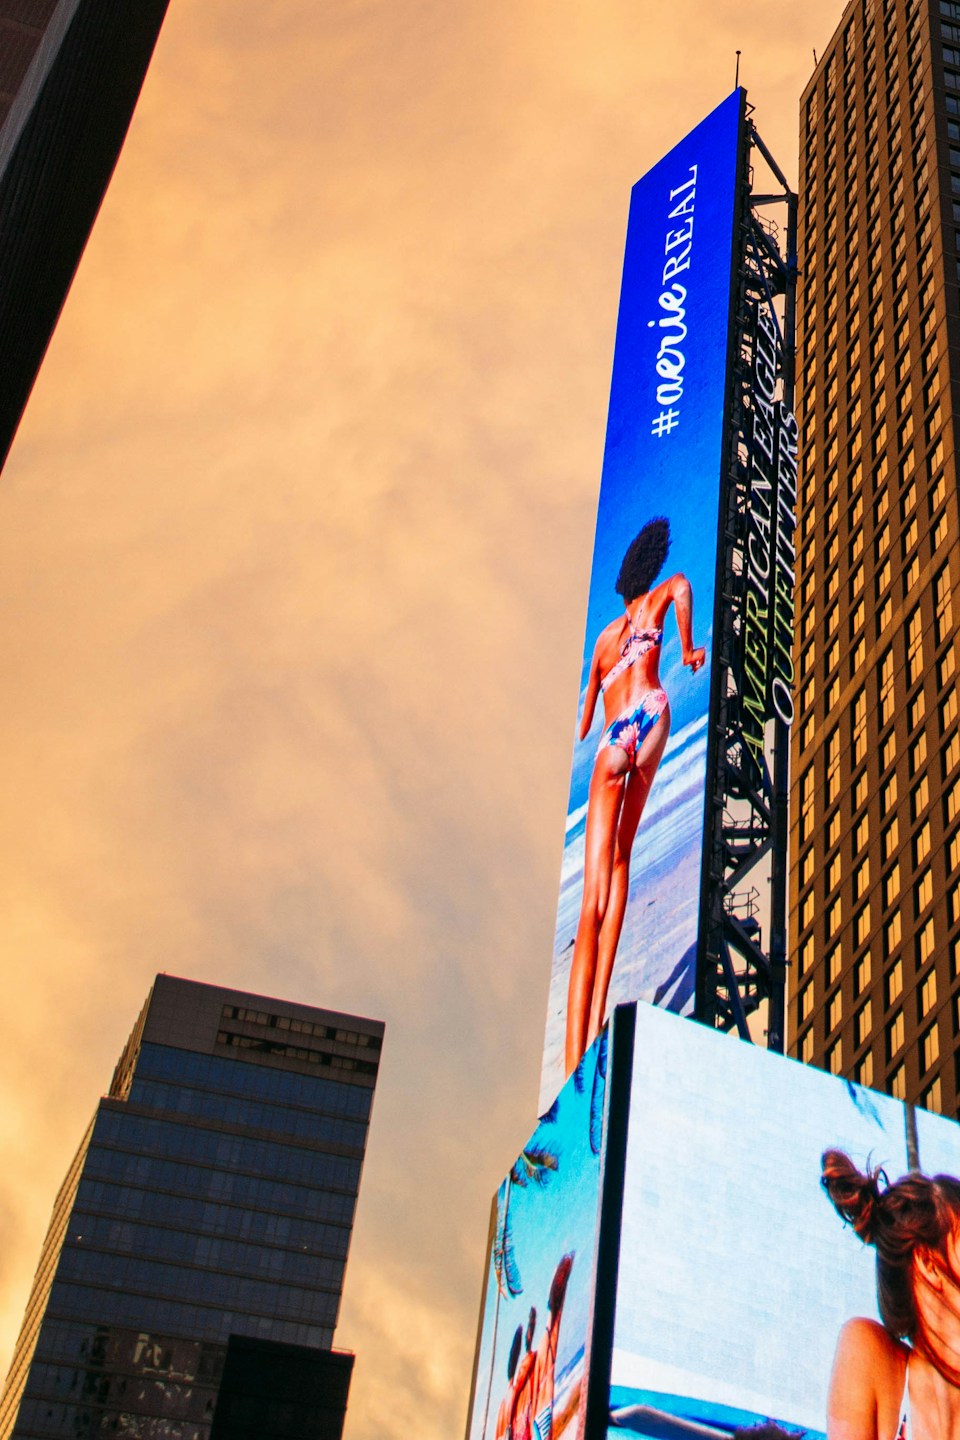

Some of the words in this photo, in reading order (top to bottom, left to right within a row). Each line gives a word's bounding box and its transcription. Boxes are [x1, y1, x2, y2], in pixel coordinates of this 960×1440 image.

[752, 302, 780, 462] EAGLE
[741, 460, 773, 782] AMERICAN
[771, 400, 801, 726] OUTFITTERS
